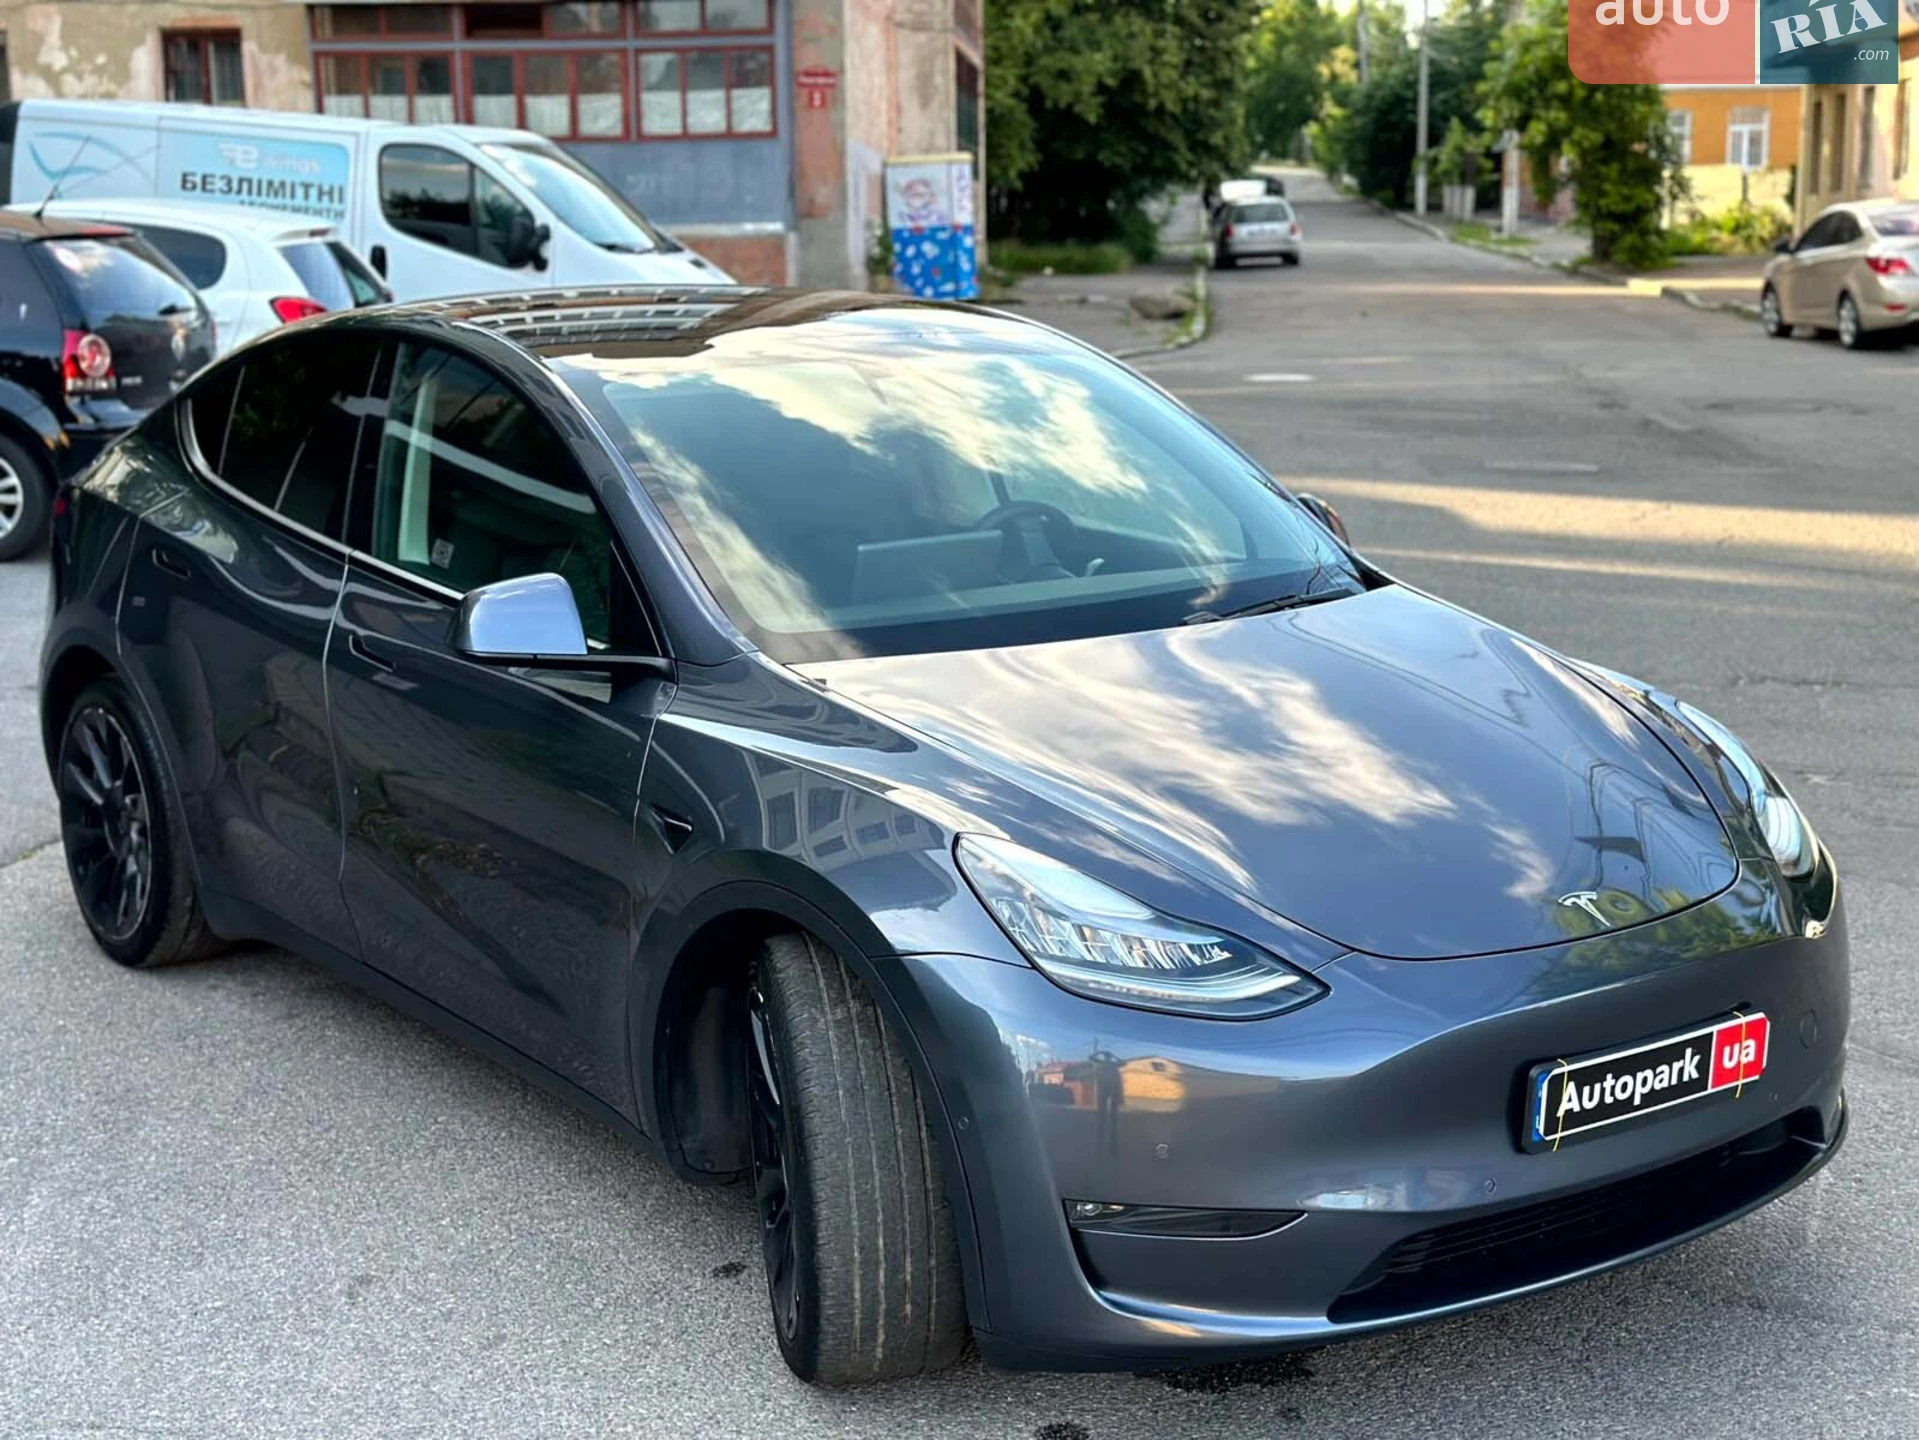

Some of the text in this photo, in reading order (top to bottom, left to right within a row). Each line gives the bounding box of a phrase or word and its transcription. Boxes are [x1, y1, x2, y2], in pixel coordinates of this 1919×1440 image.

[180, 171, 345, 205] БЕЗЛІМІТНІ
[1556, 1038, 1756, 1117] Autopark ua
